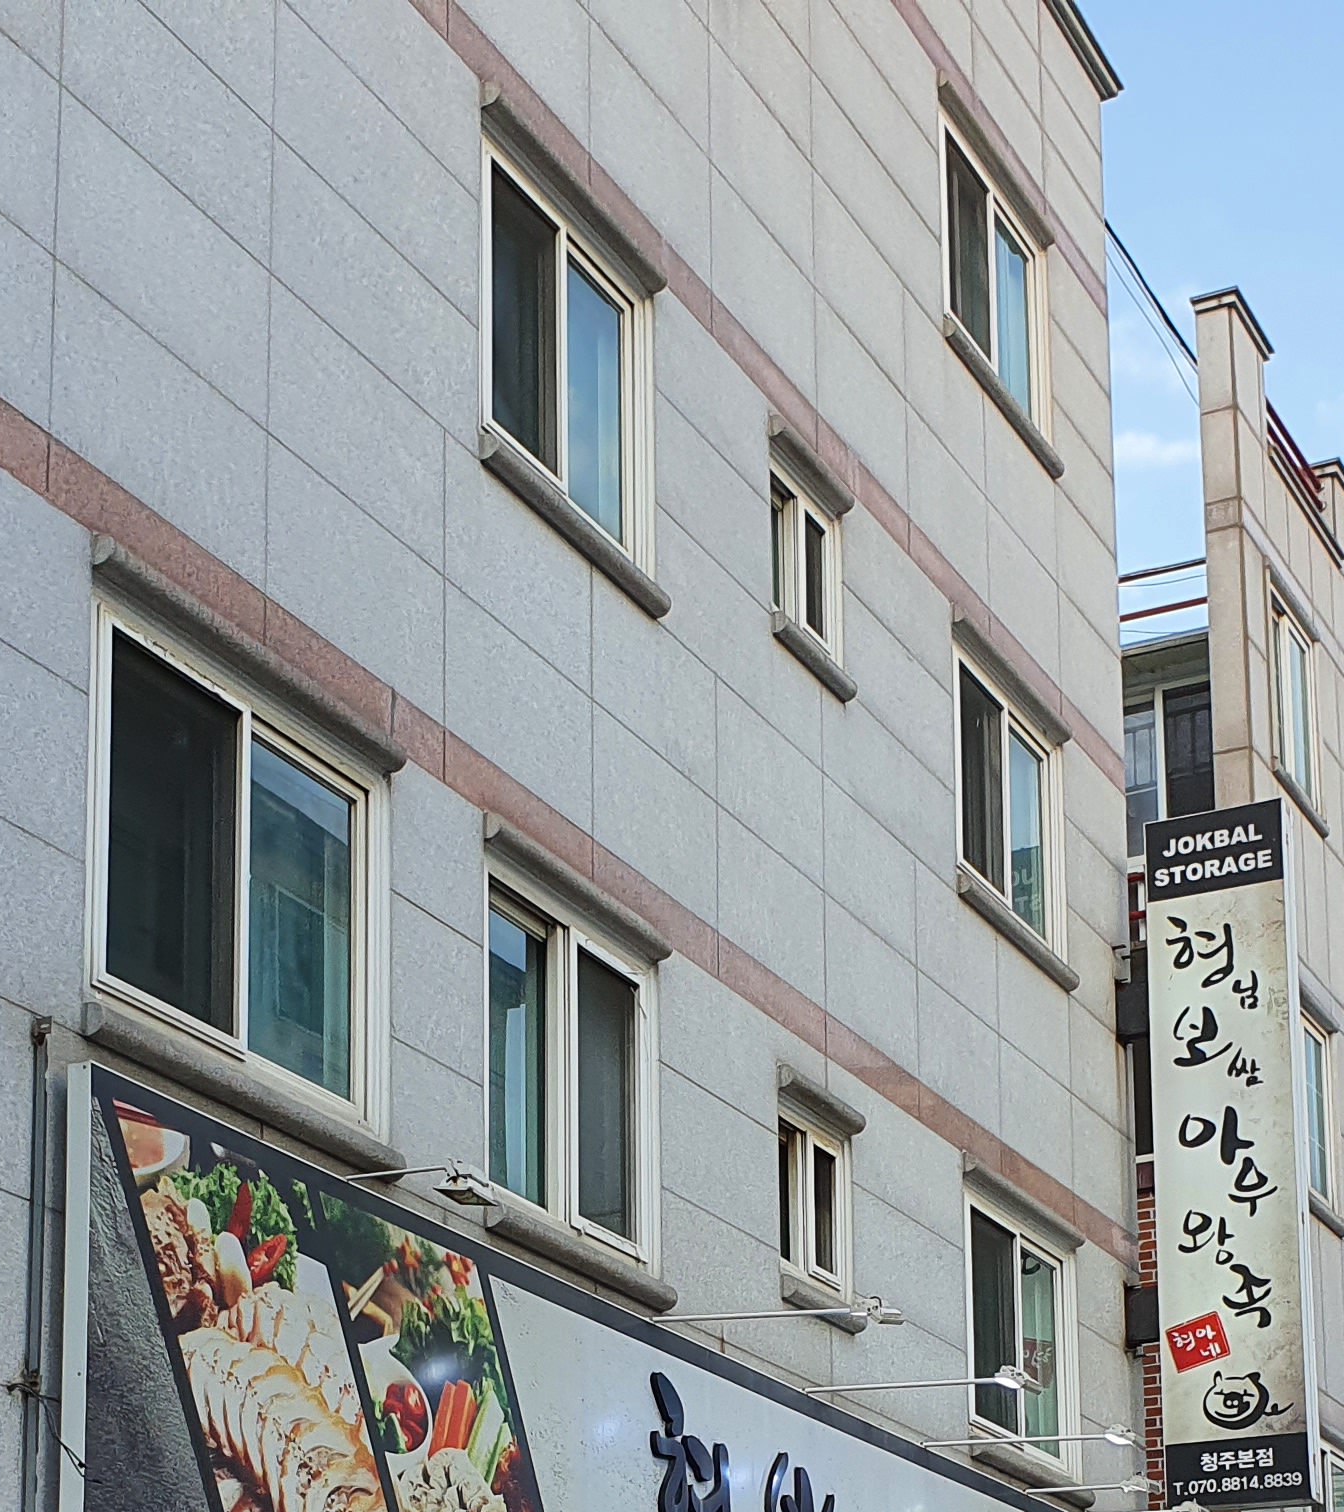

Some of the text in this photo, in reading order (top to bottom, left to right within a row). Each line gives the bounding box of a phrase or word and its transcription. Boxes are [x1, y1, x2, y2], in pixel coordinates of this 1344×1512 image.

[1161, 822, 1263, 859] JOKBAL
[1153, 848, 1274, 889] STORAGE
[1164, 914, 1260, 1010] 형님
[1172, 1005, 1265, 1089] 보쌈
[1199, 1447, 1275, 1474] 청주본점
[1172, 1471, 1304, 1497] T.070.8814.8839
